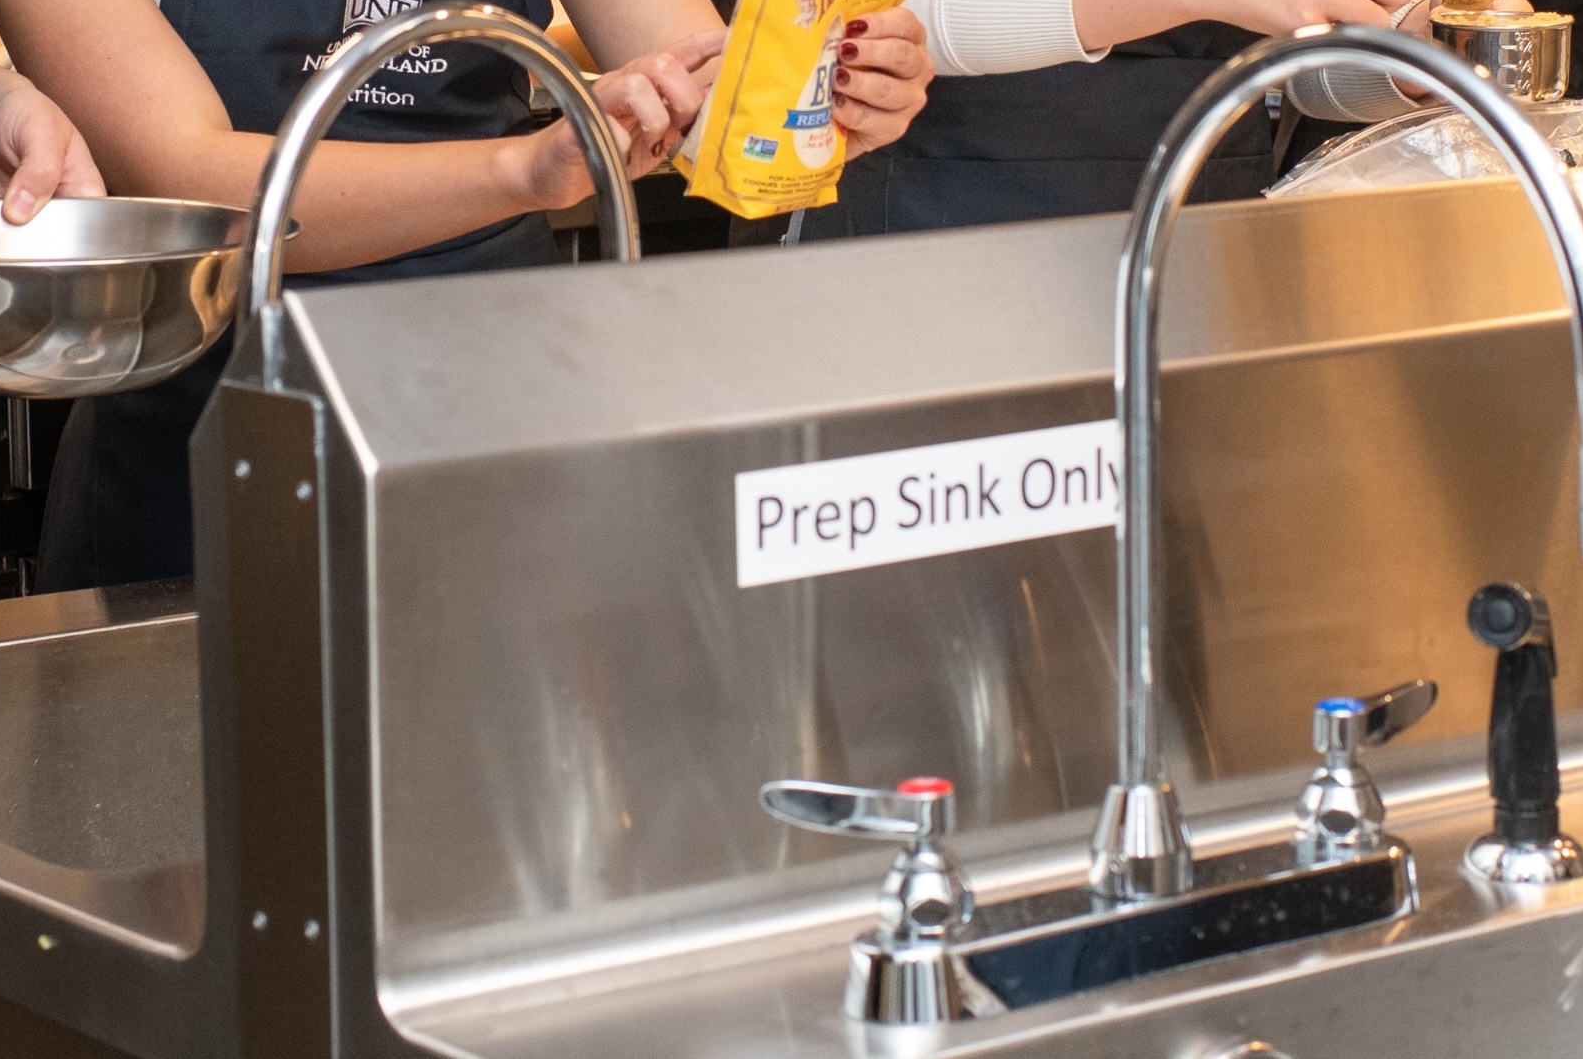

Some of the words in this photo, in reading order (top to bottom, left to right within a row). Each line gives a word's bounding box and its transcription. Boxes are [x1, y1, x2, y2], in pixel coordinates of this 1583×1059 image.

[408, 45, 431, 58] OF
[756, 494, 878, 552] Prep
[898, 463, 1002, 530] Sink
